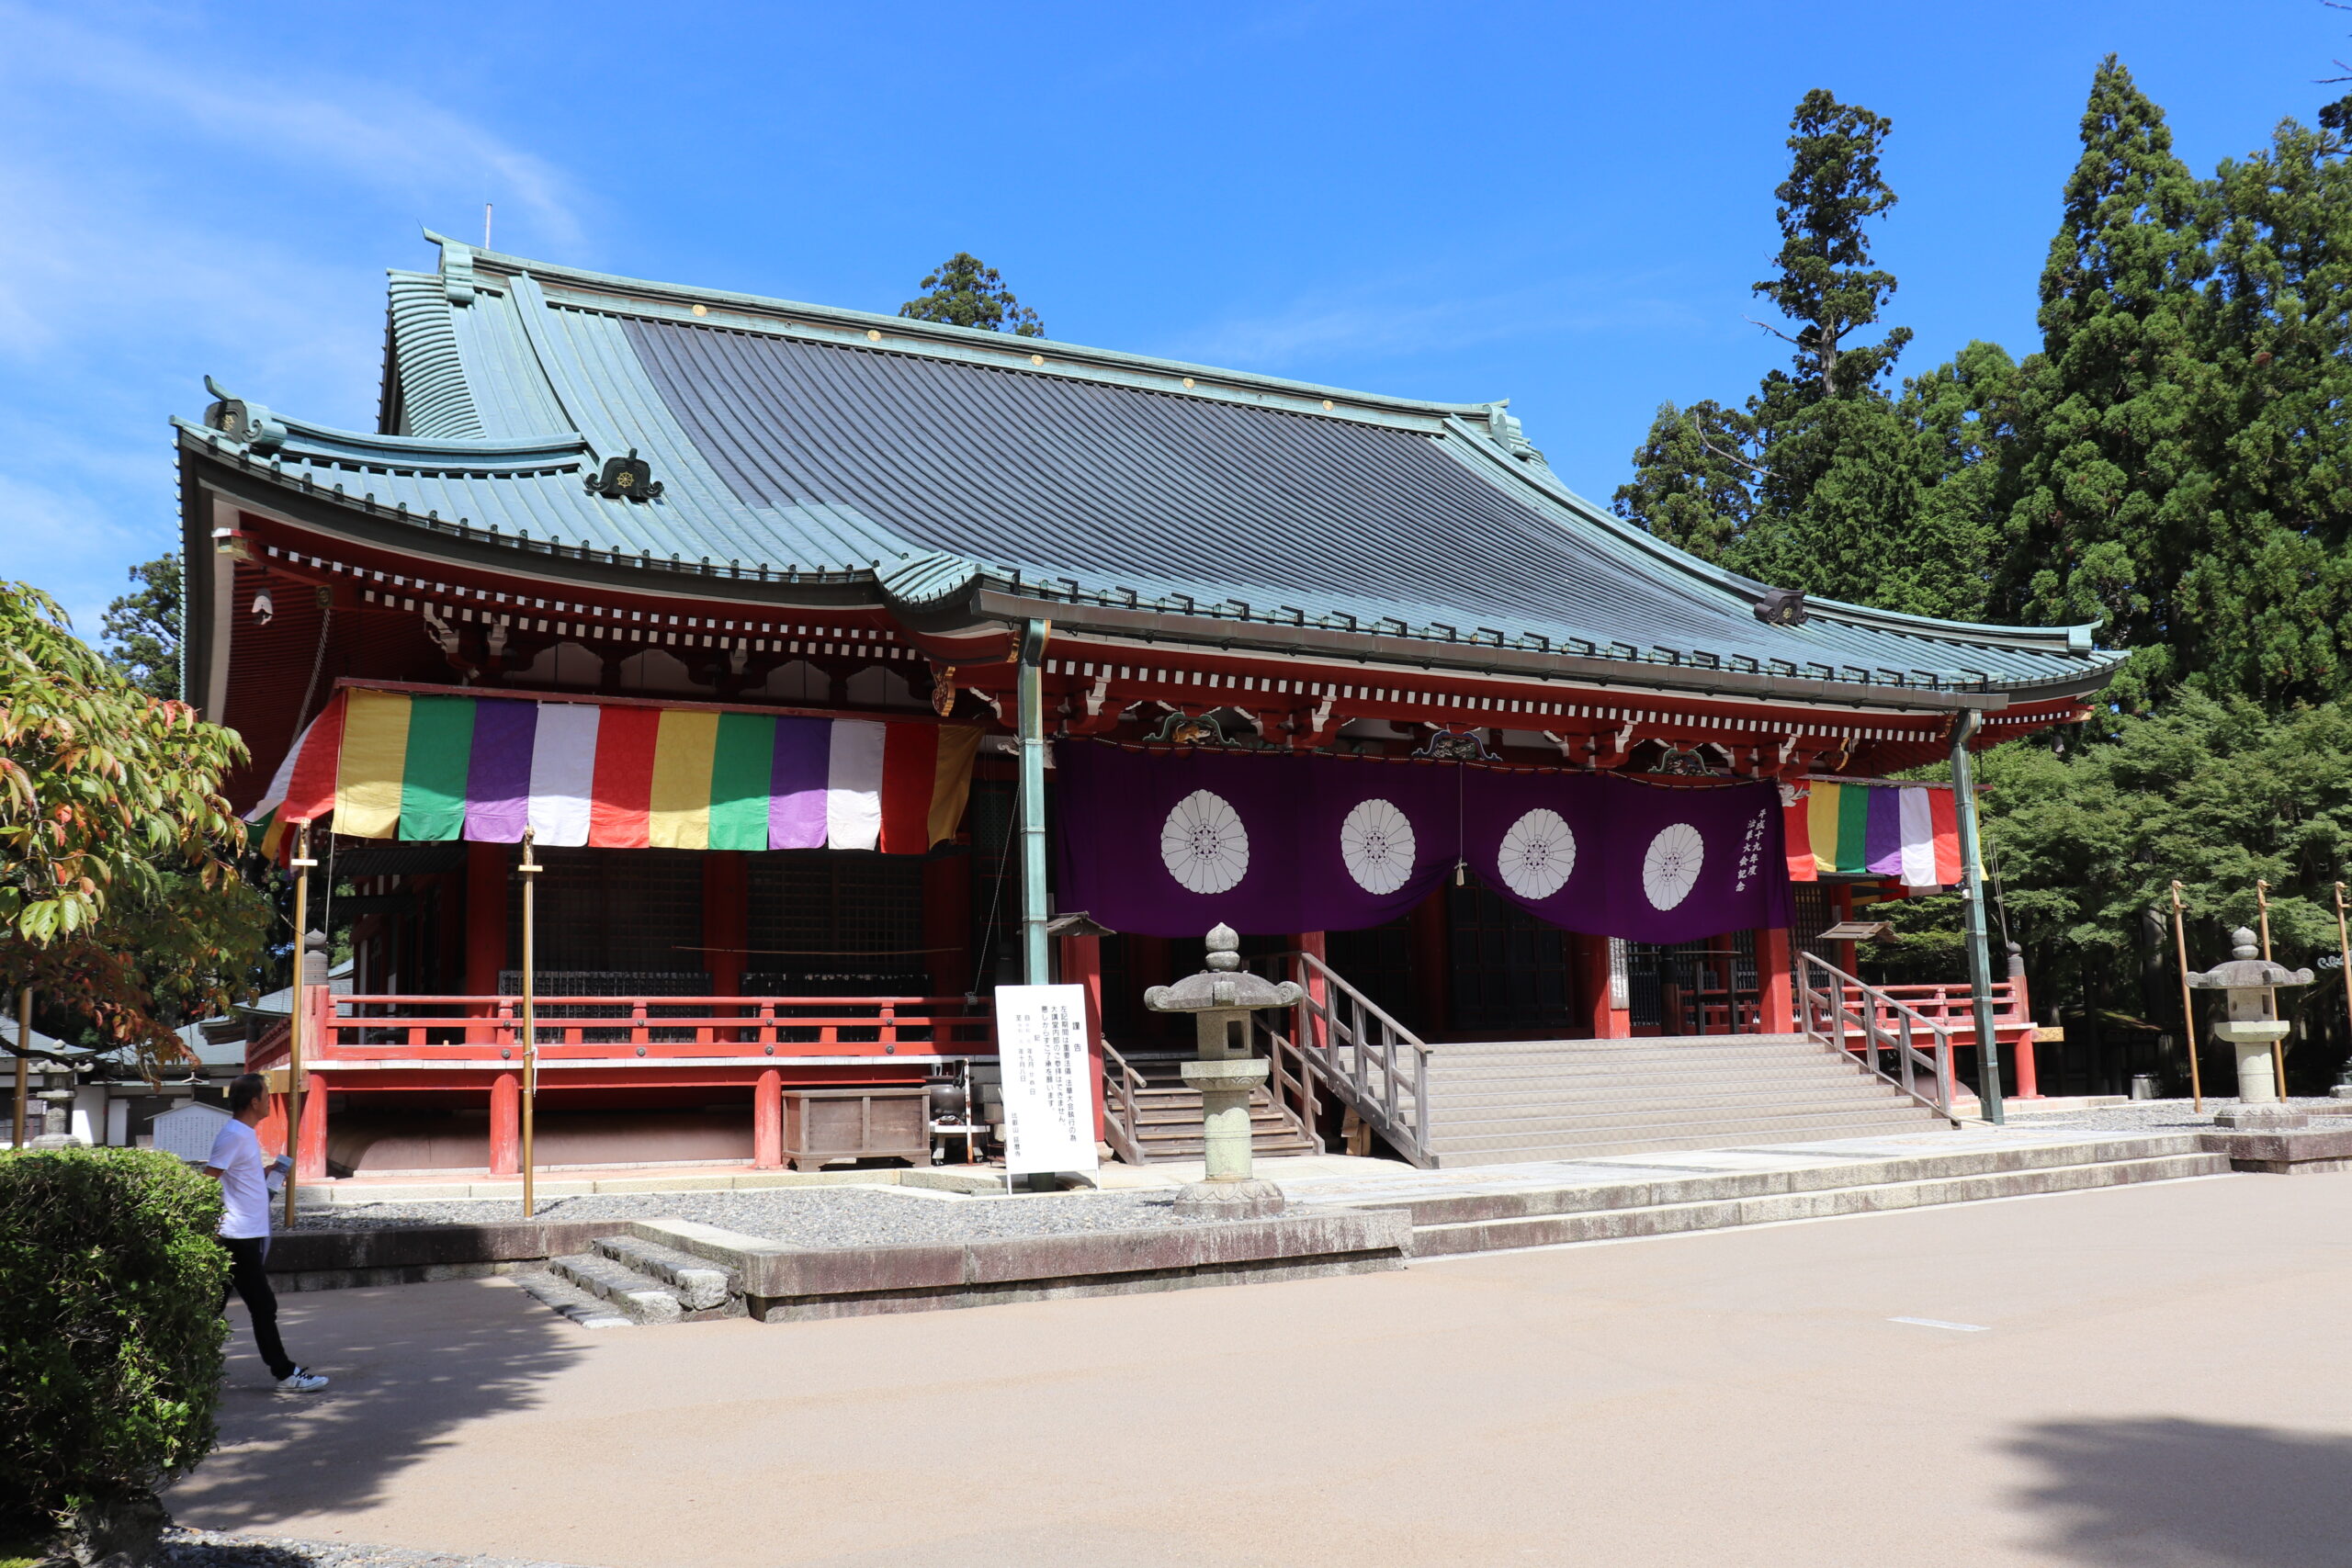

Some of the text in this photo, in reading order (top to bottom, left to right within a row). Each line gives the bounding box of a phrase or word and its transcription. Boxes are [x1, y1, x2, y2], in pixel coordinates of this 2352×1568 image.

[1747, 808, 1767, 875] 平成十九年度
[1072, 1021, 1081, 1052] 謹告
